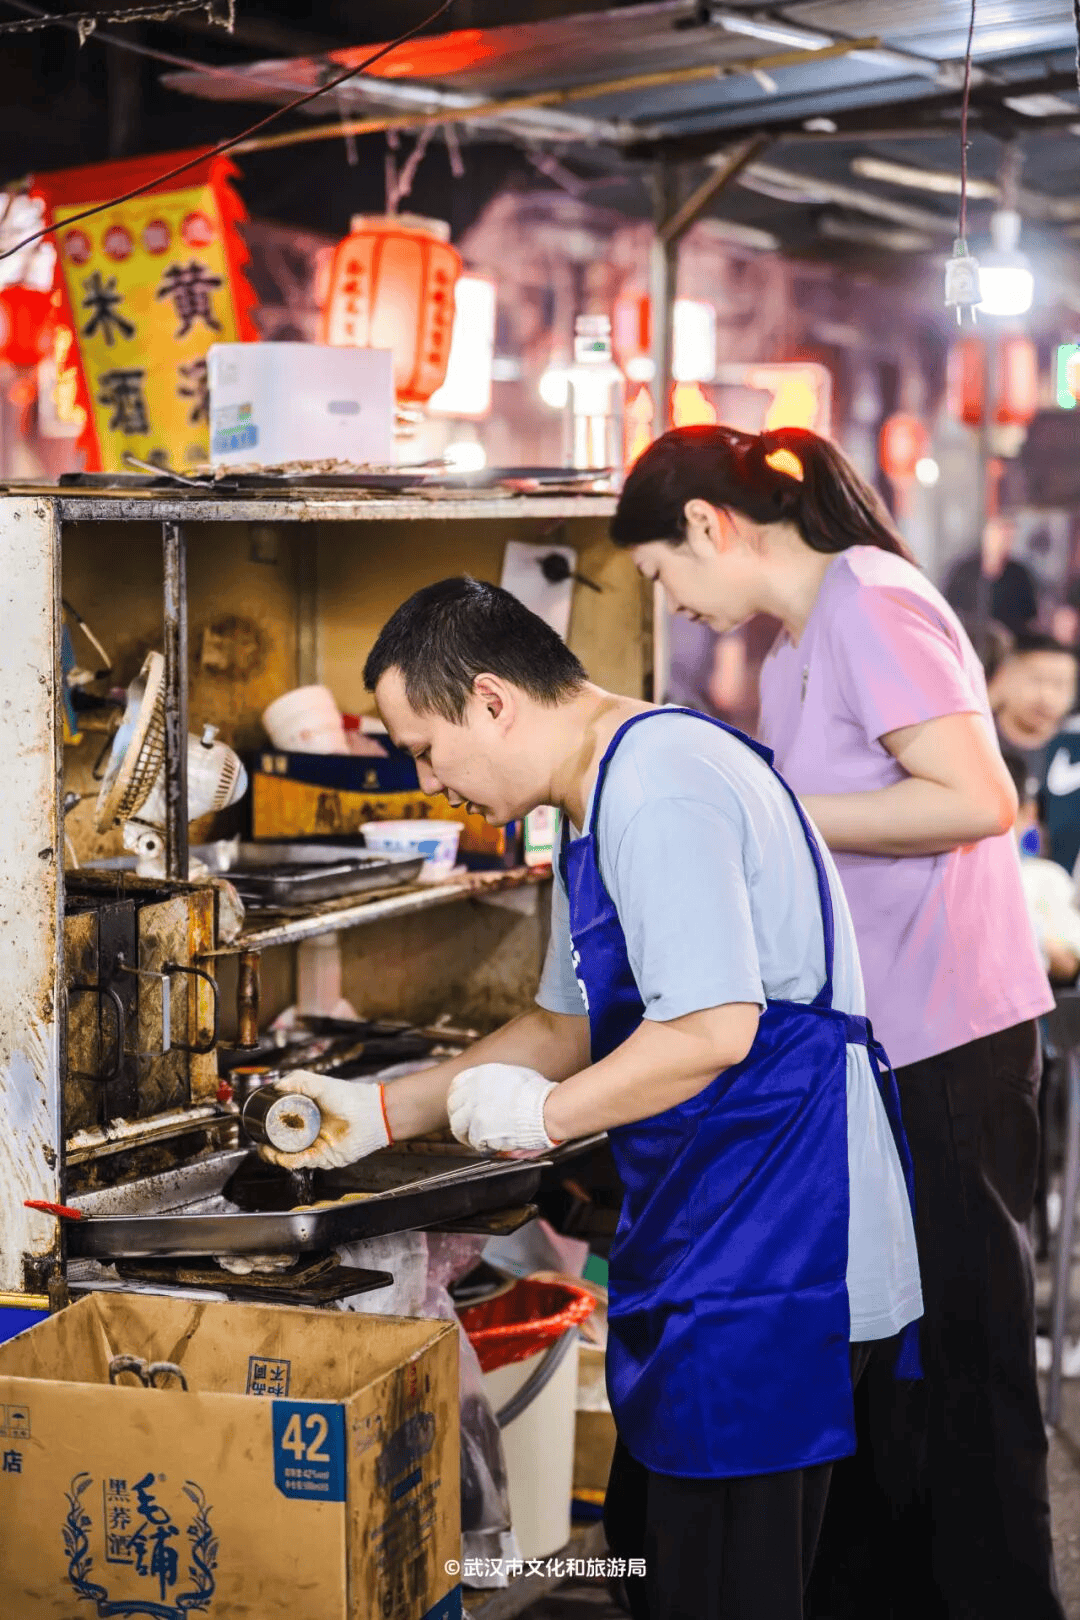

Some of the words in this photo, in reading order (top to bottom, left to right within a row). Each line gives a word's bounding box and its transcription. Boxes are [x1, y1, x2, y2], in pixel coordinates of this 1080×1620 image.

[81, 270, 150, 437] 米酒
[3, 1449, 23, 1474] 店
[281, 1413, 330, 1462] 42
